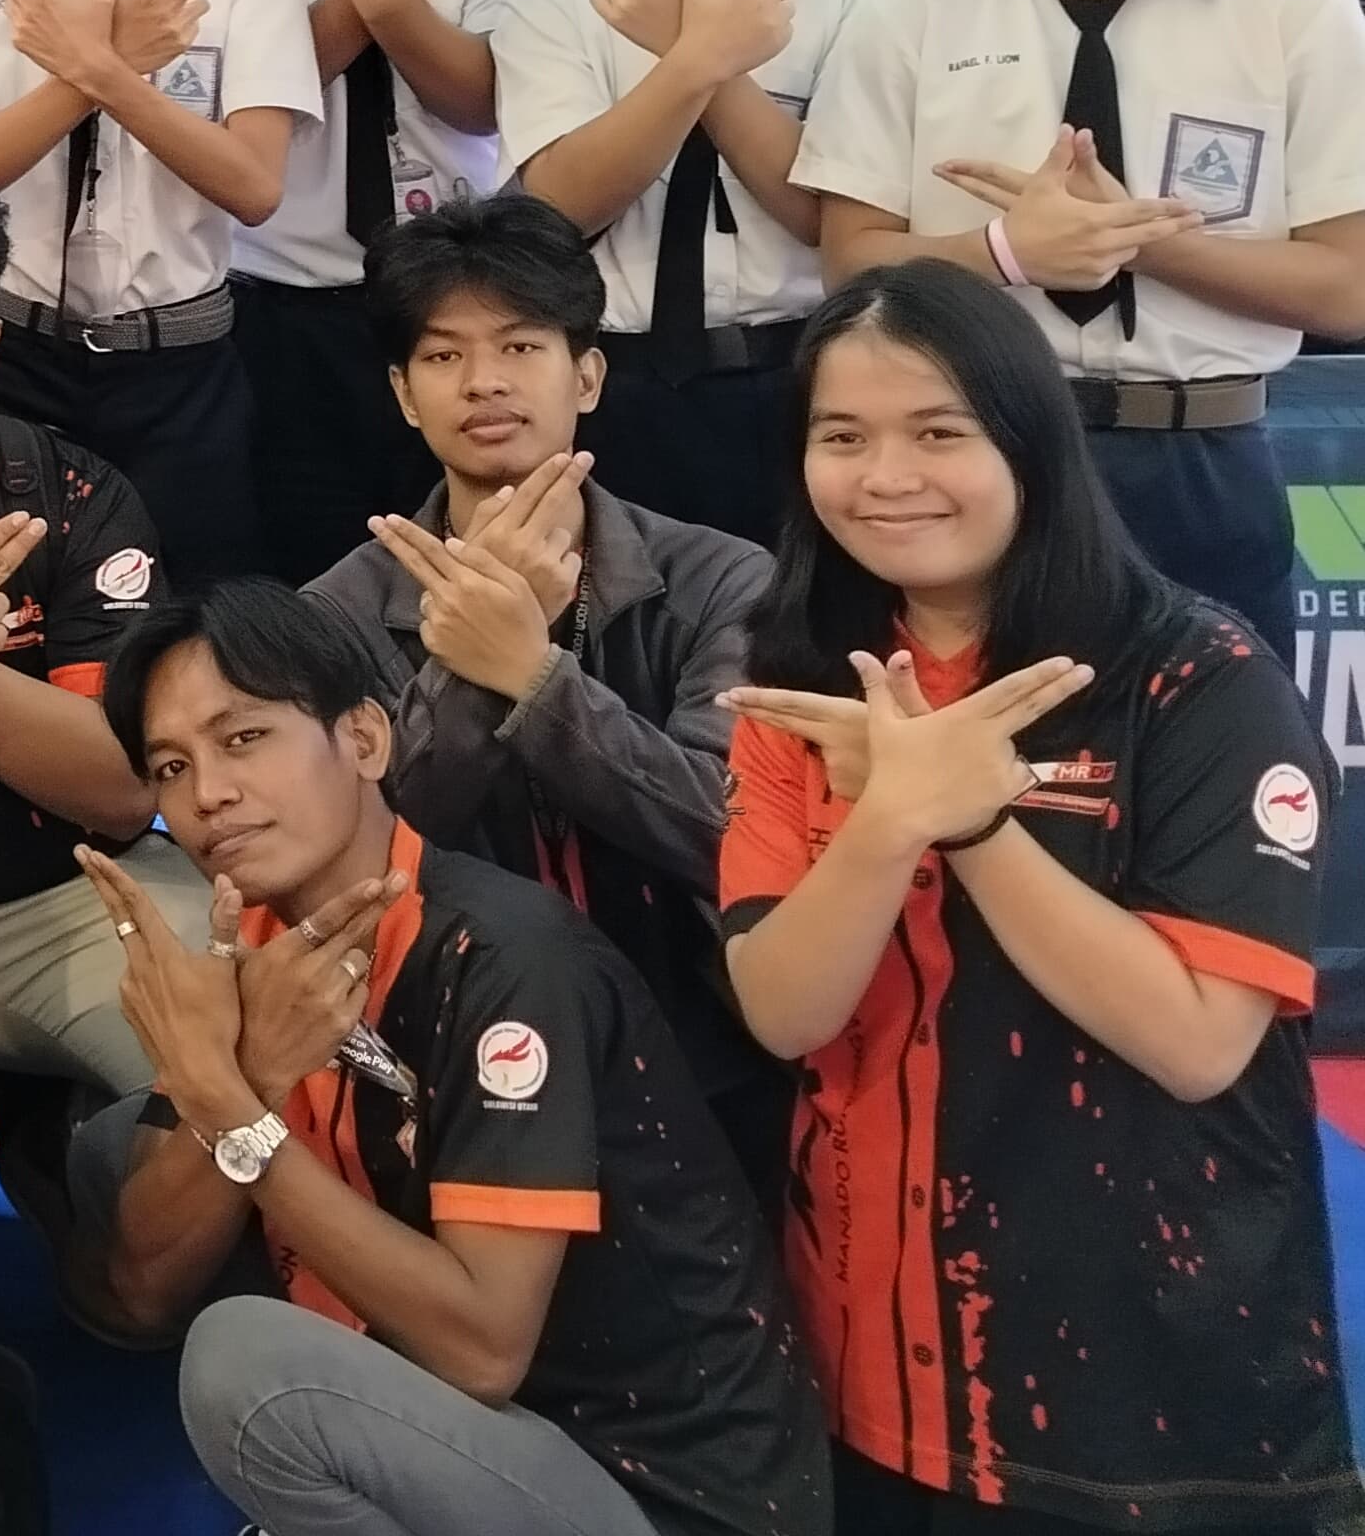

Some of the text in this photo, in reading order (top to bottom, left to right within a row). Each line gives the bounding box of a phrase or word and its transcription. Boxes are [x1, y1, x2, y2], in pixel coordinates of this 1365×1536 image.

[341, 1045, 394, 1075] oogle Play
[834, 1160, 852, 1284] MANADO
